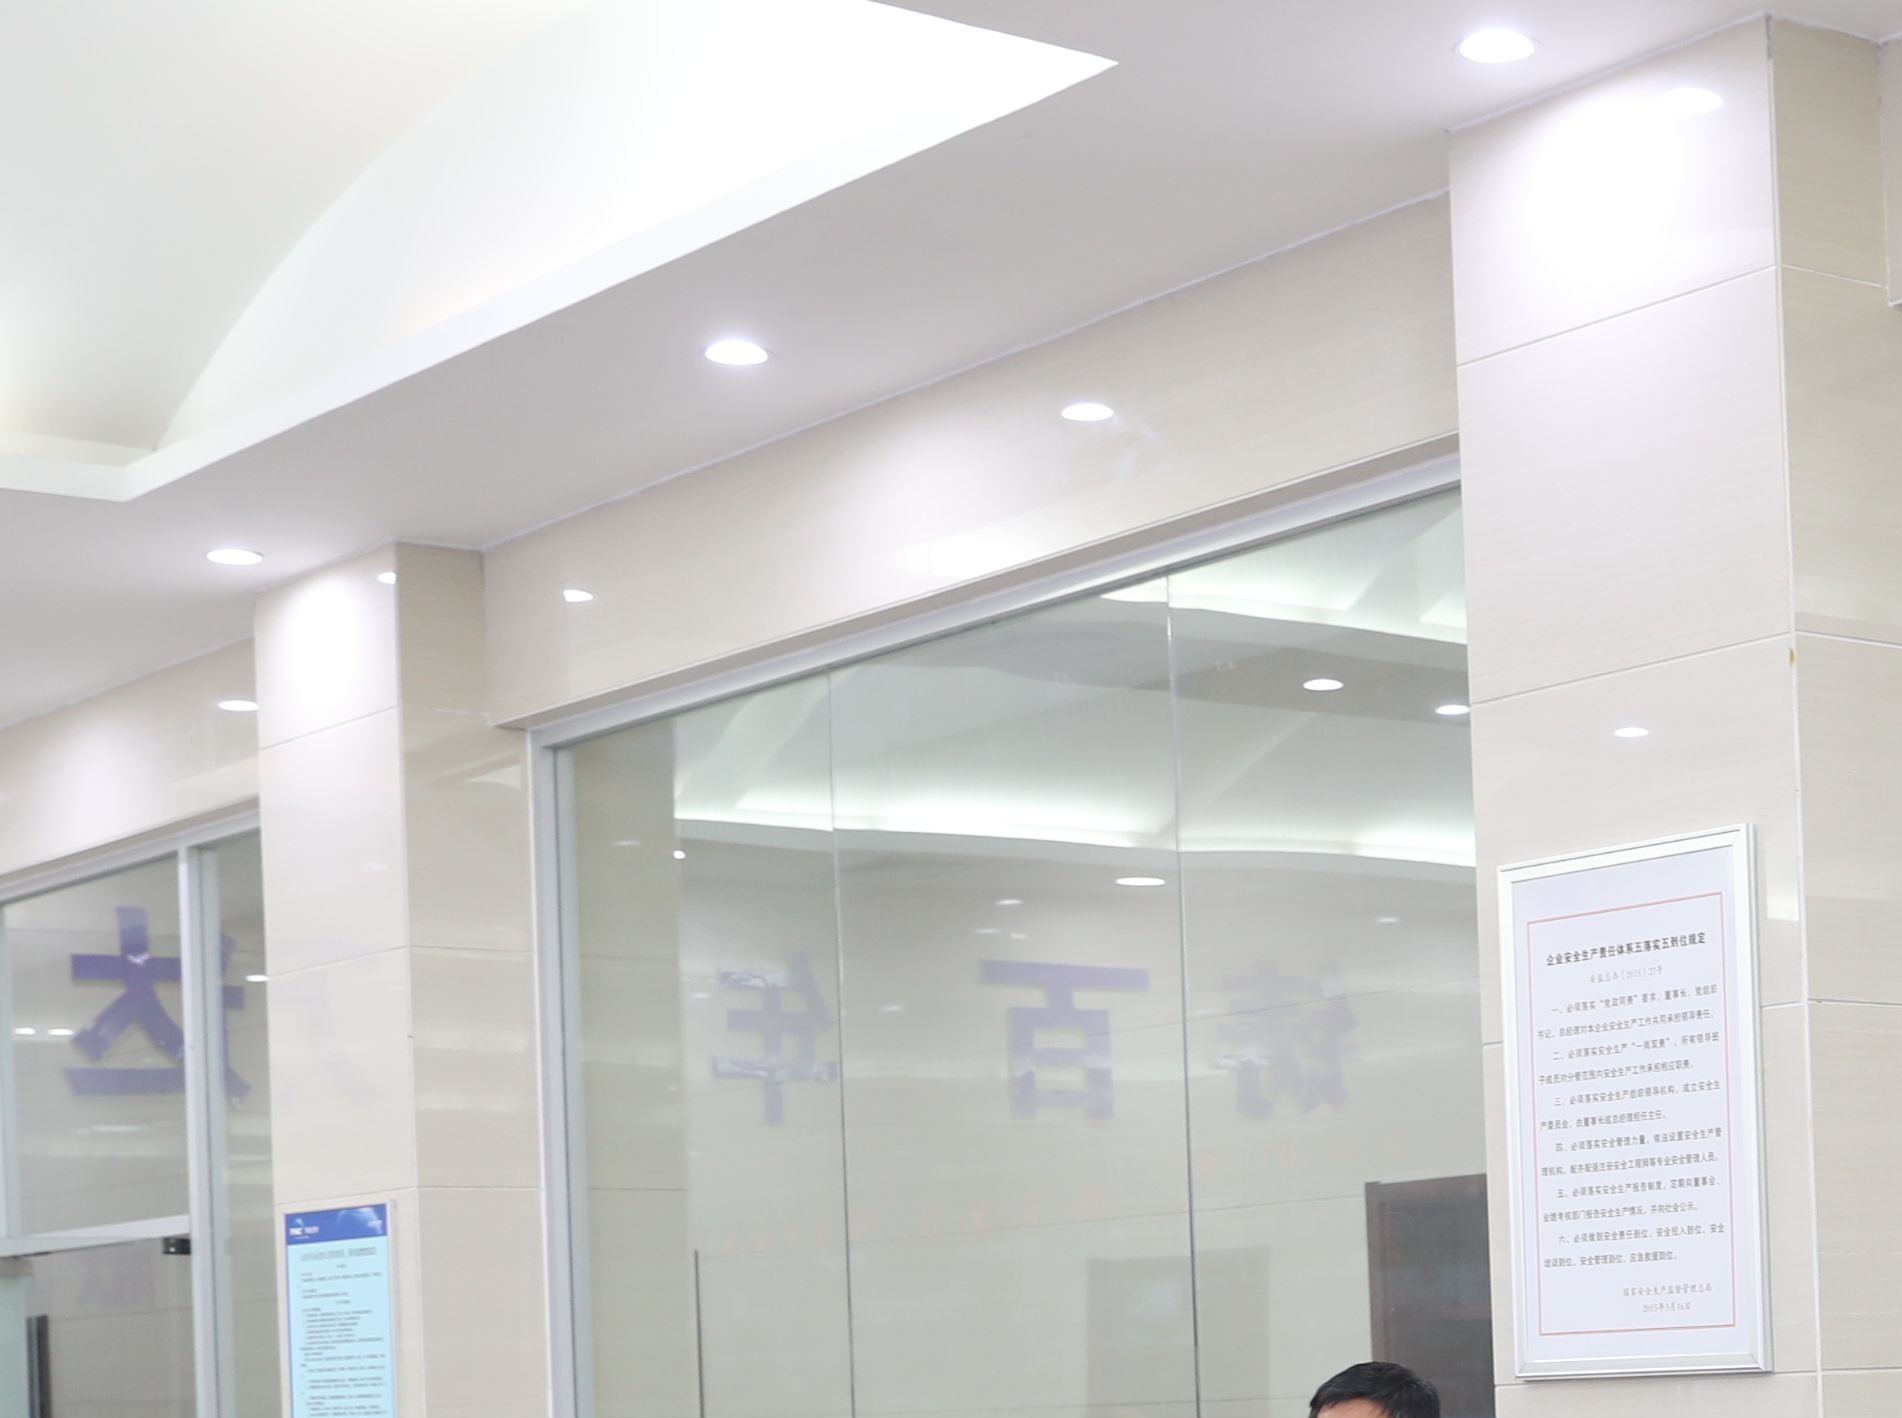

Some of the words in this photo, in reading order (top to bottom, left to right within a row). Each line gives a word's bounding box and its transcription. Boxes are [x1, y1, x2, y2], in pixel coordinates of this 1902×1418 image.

[1546, 931, 1706, 967] 企业安全生产责任体系五落实五到位规定
